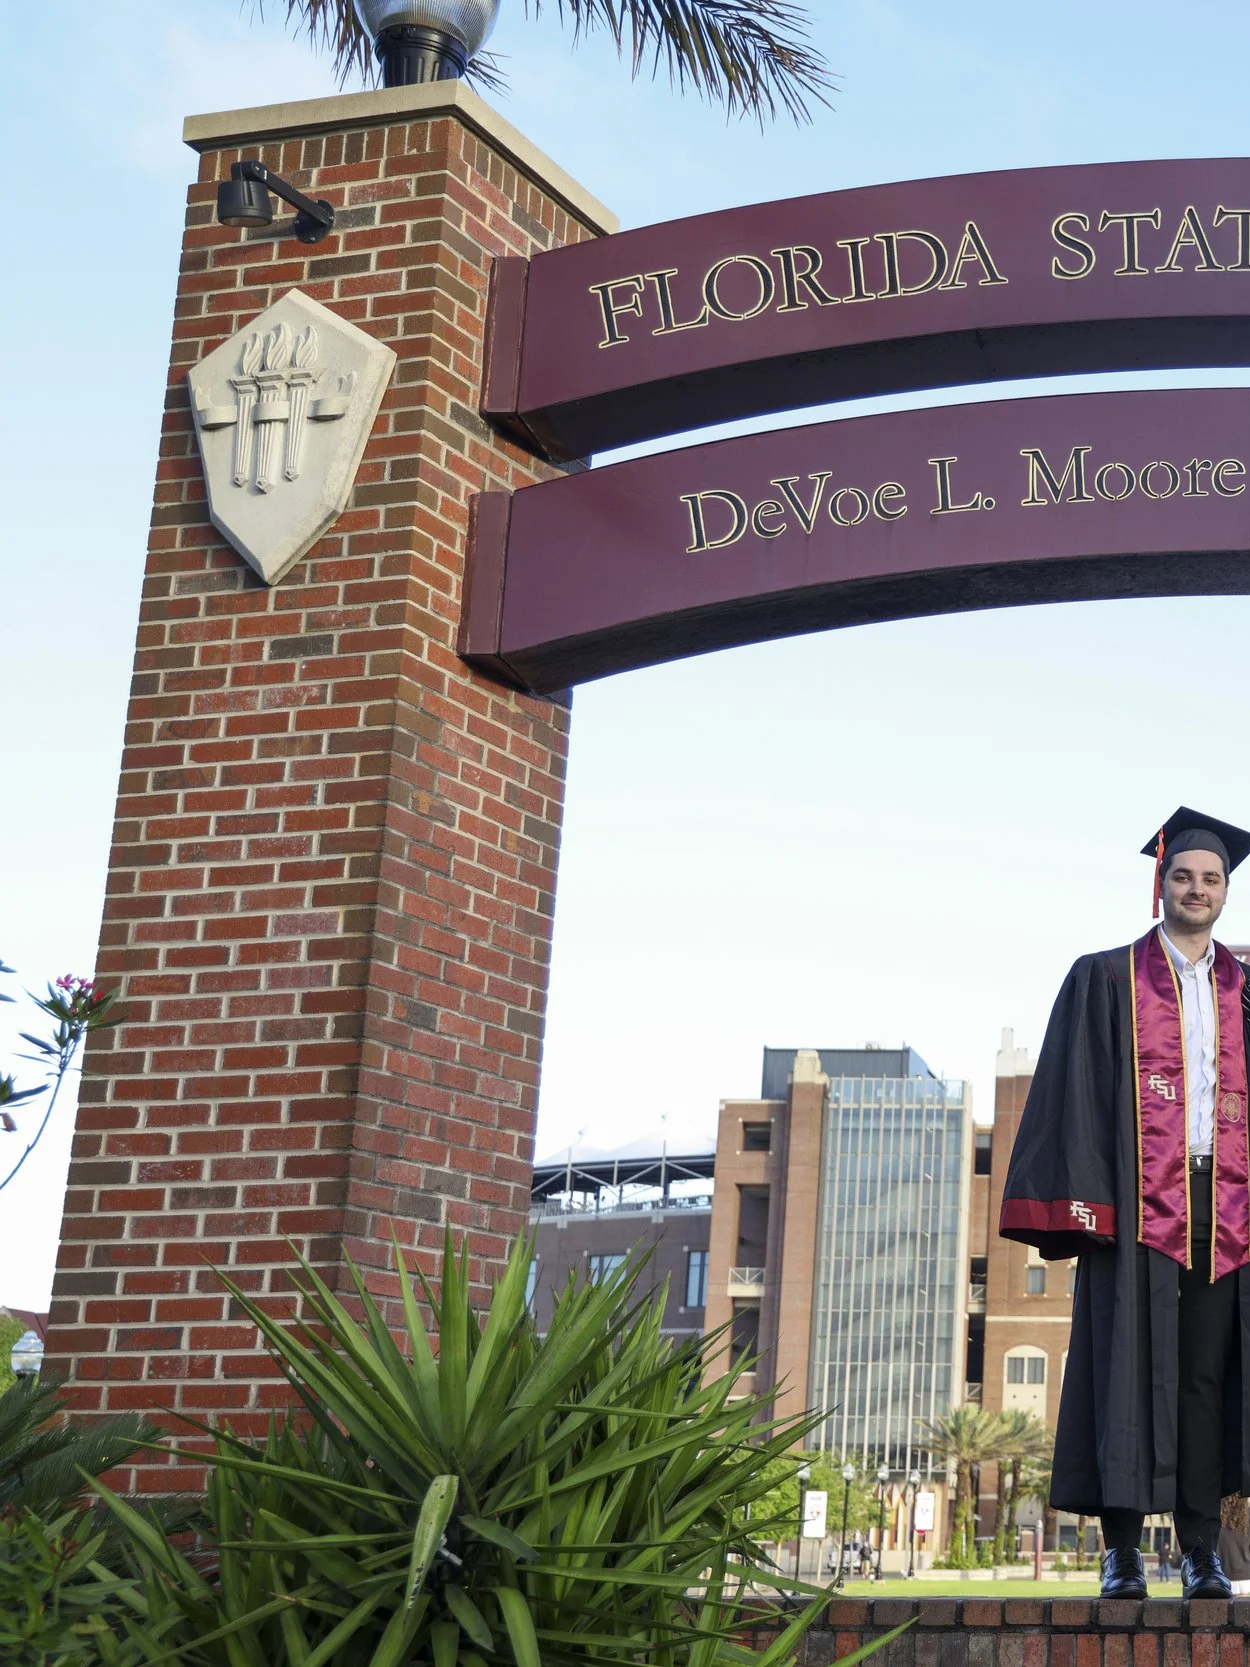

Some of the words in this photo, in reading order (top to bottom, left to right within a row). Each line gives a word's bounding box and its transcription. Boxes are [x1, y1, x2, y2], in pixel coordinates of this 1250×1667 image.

[589, 221, 1008, 349] FLORIDA
[680, 471, 907, 553] DeVoe
[930, 456, 996, 515] L.
[1020, 446, 1246, 506] Moore
[1148, 1074, 1177, 1100] FSU
[1070, 1200, 1097, 1231] FSU
